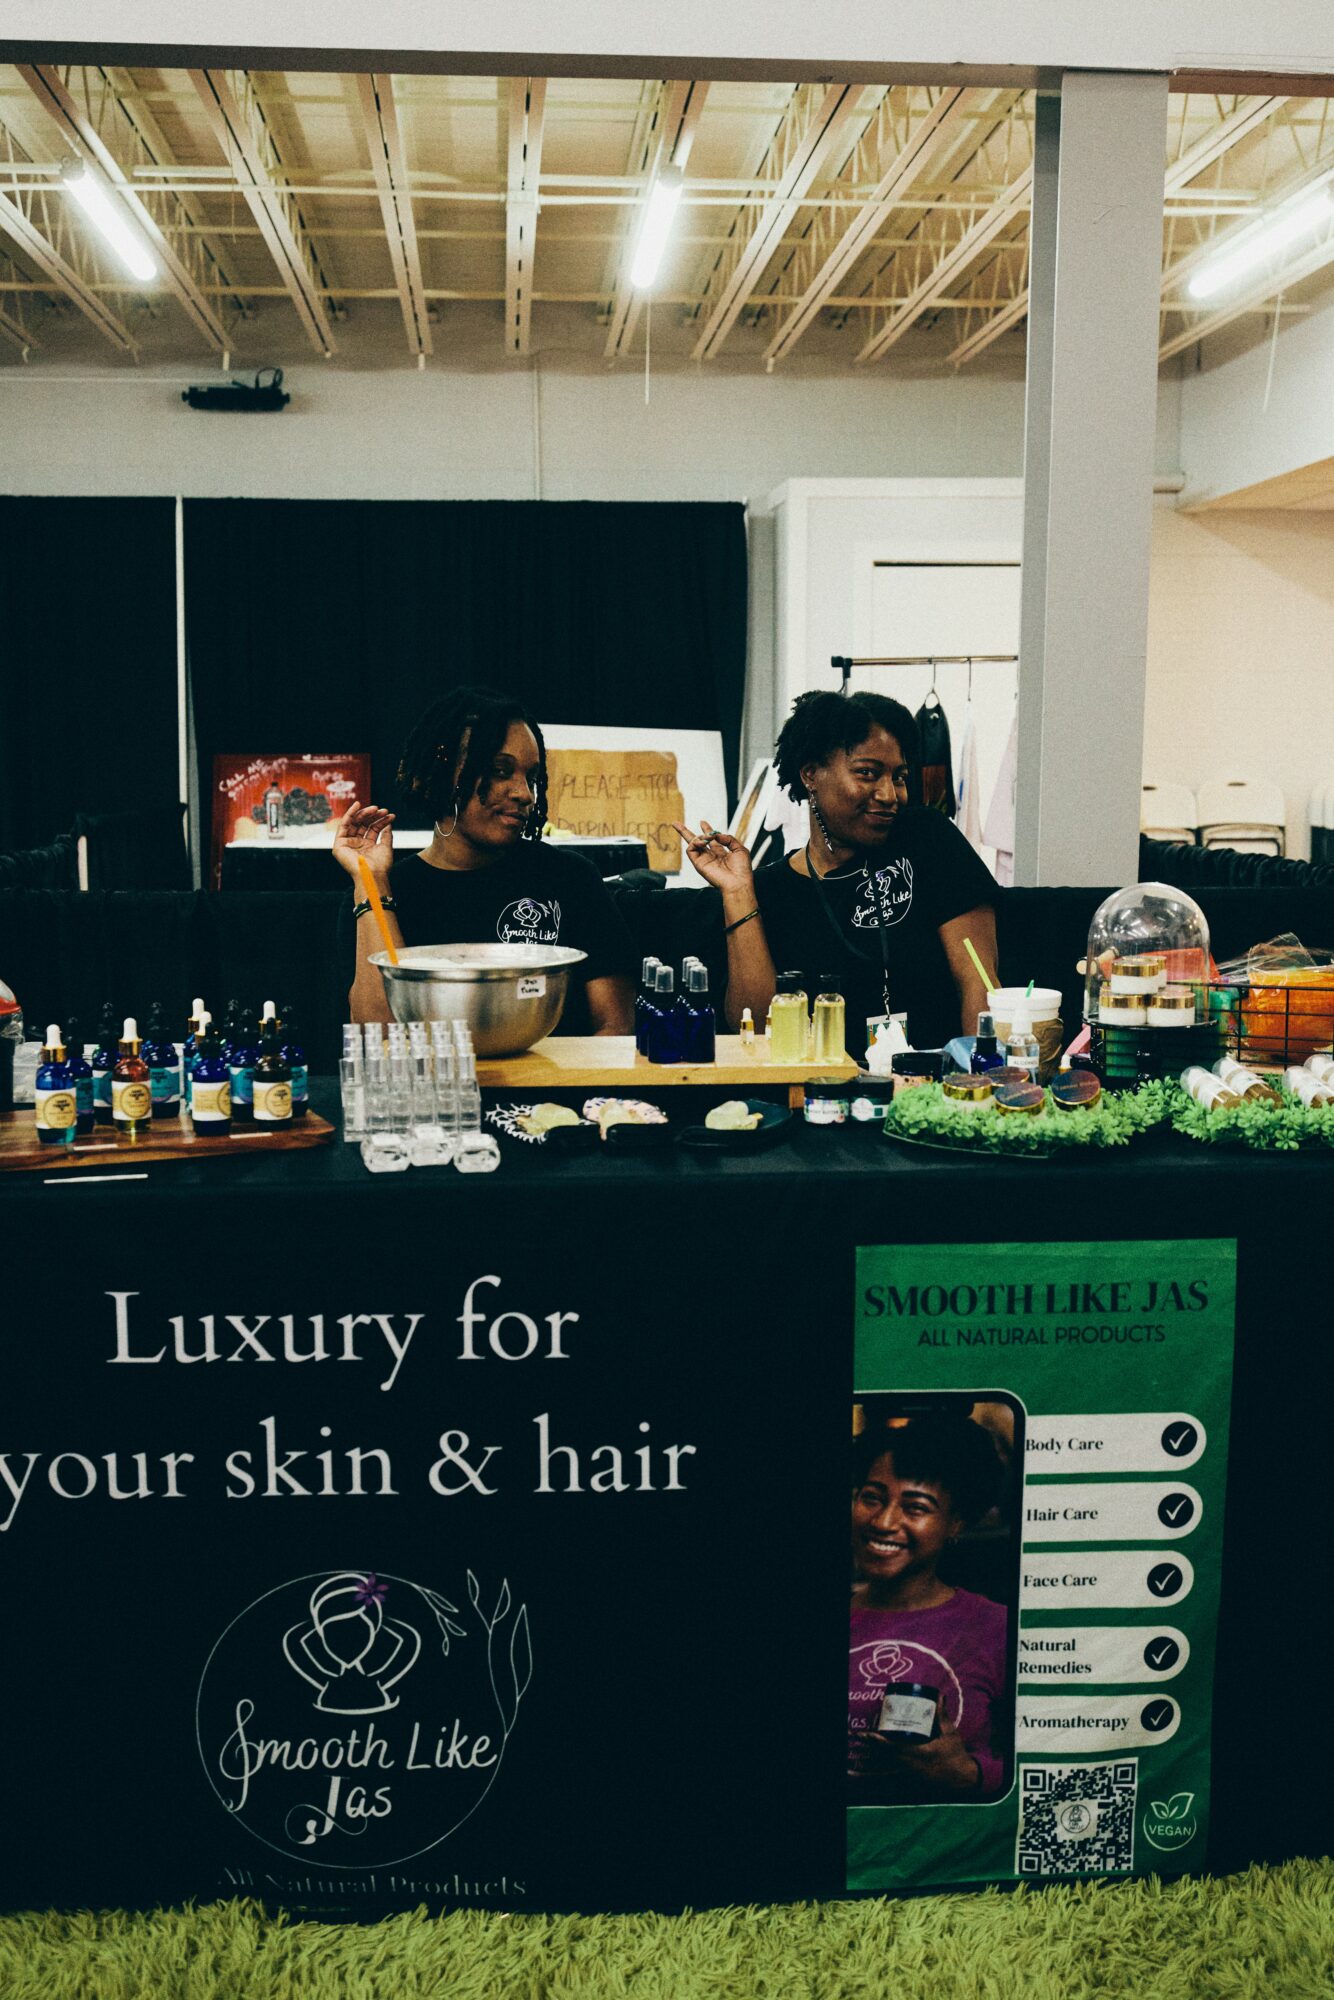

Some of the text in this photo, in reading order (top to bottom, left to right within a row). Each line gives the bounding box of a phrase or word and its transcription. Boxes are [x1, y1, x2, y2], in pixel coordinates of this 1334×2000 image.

[559, 772, 676, 801] PLEASE STOP
[892, 890, 912, 904] Like
[501, 923, 559, 944] Smooth Like
[864, 1280, 1209, 1317] SMOOTH LIKE JAS
[105, 1274, 580, 1392] Luxury for
[917, 1324, 1166, 1347] ALL NATURAL PRODUCTS
[1025, 1437, 1104, 1454] Body Care
[0, 1412, 697, 1532] your skin & hair
[1027, 1507, 1099, 1521] Hair Care
[1023, 1574, 1098, 1587] Face Care
[1020, 1638, 1076, 1652] Natural
[1018, 1660, 1092, 1675] Remedies
[1019, 1714, 1130, 1731] Aromatherapy
[219, 1699, 498, 1812] Smooth Like
[285, 1775, 393, 1845] Jas
[1148, 1823, 1192, 1837] VEGAN
[265, 1874, 377, 1894] Natural
[390, 1874, 527, 1897] Products
